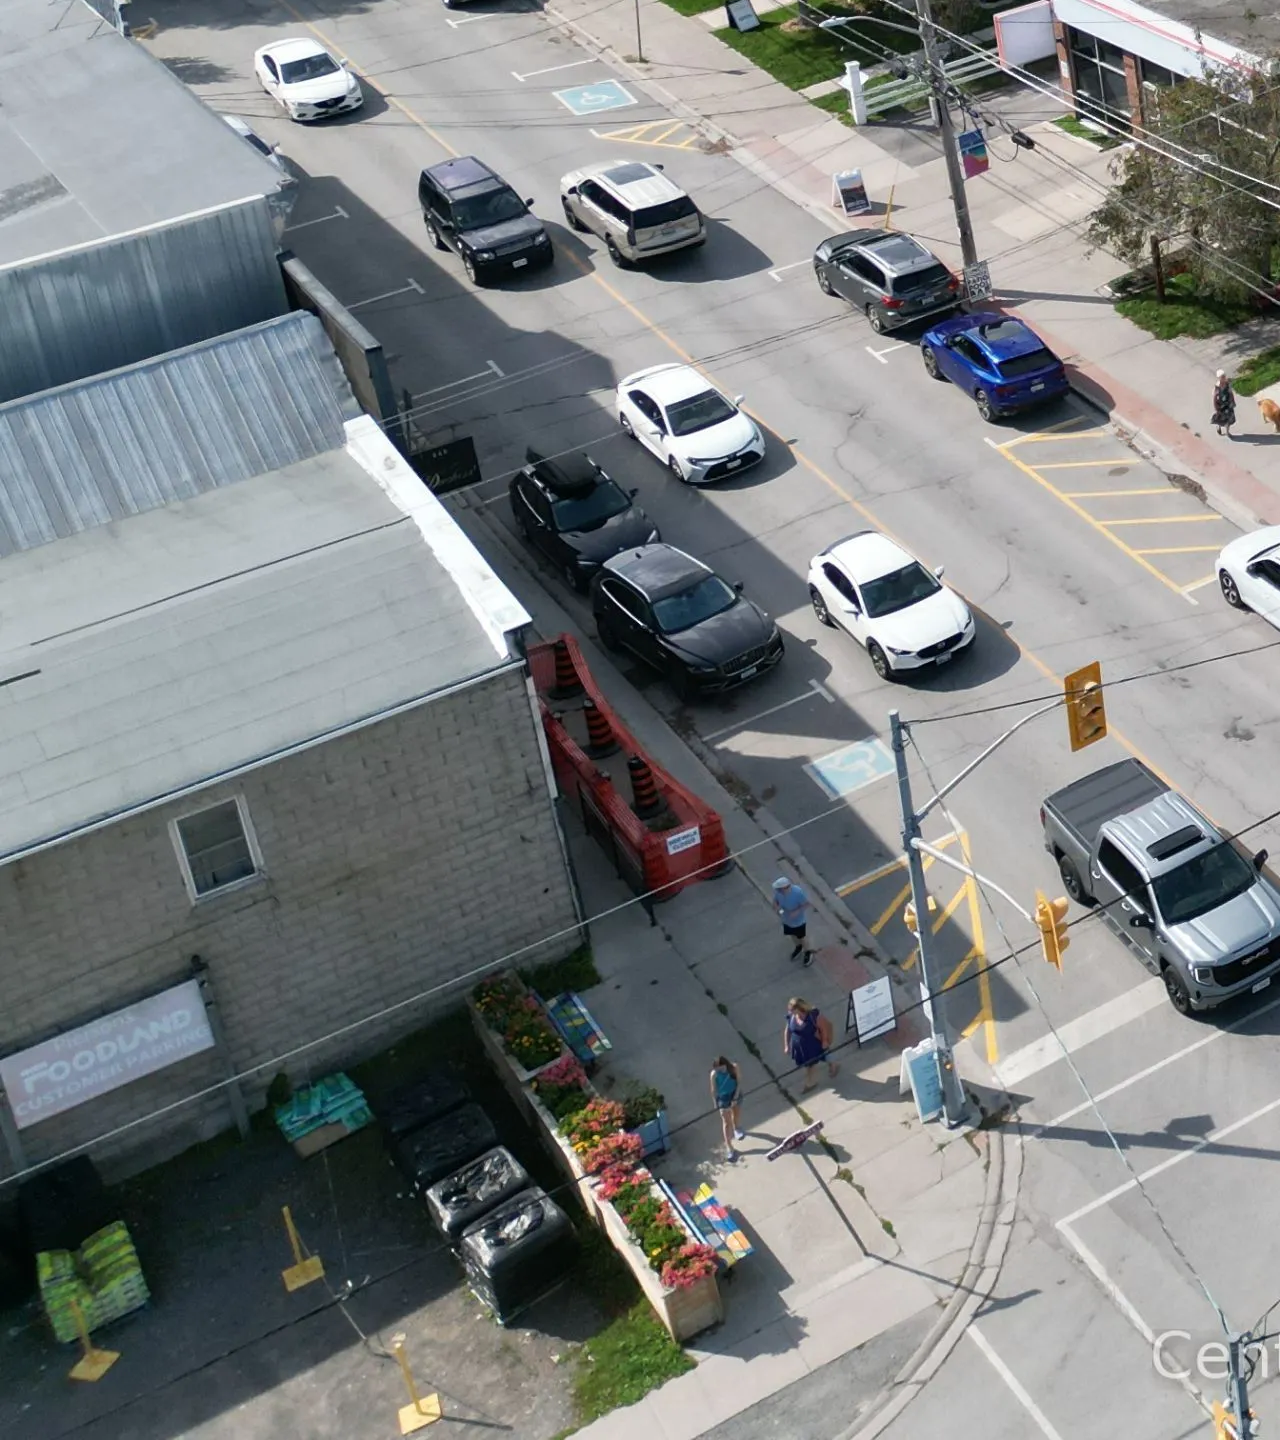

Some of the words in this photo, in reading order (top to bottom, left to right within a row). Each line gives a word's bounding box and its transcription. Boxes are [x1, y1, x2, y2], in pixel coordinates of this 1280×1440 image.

[16, 1062, 124, 1117] CUSTOMER
[127, 1024, 210, 1069] PARKING
[20, 1010, 192, 1093] FOODLAND
